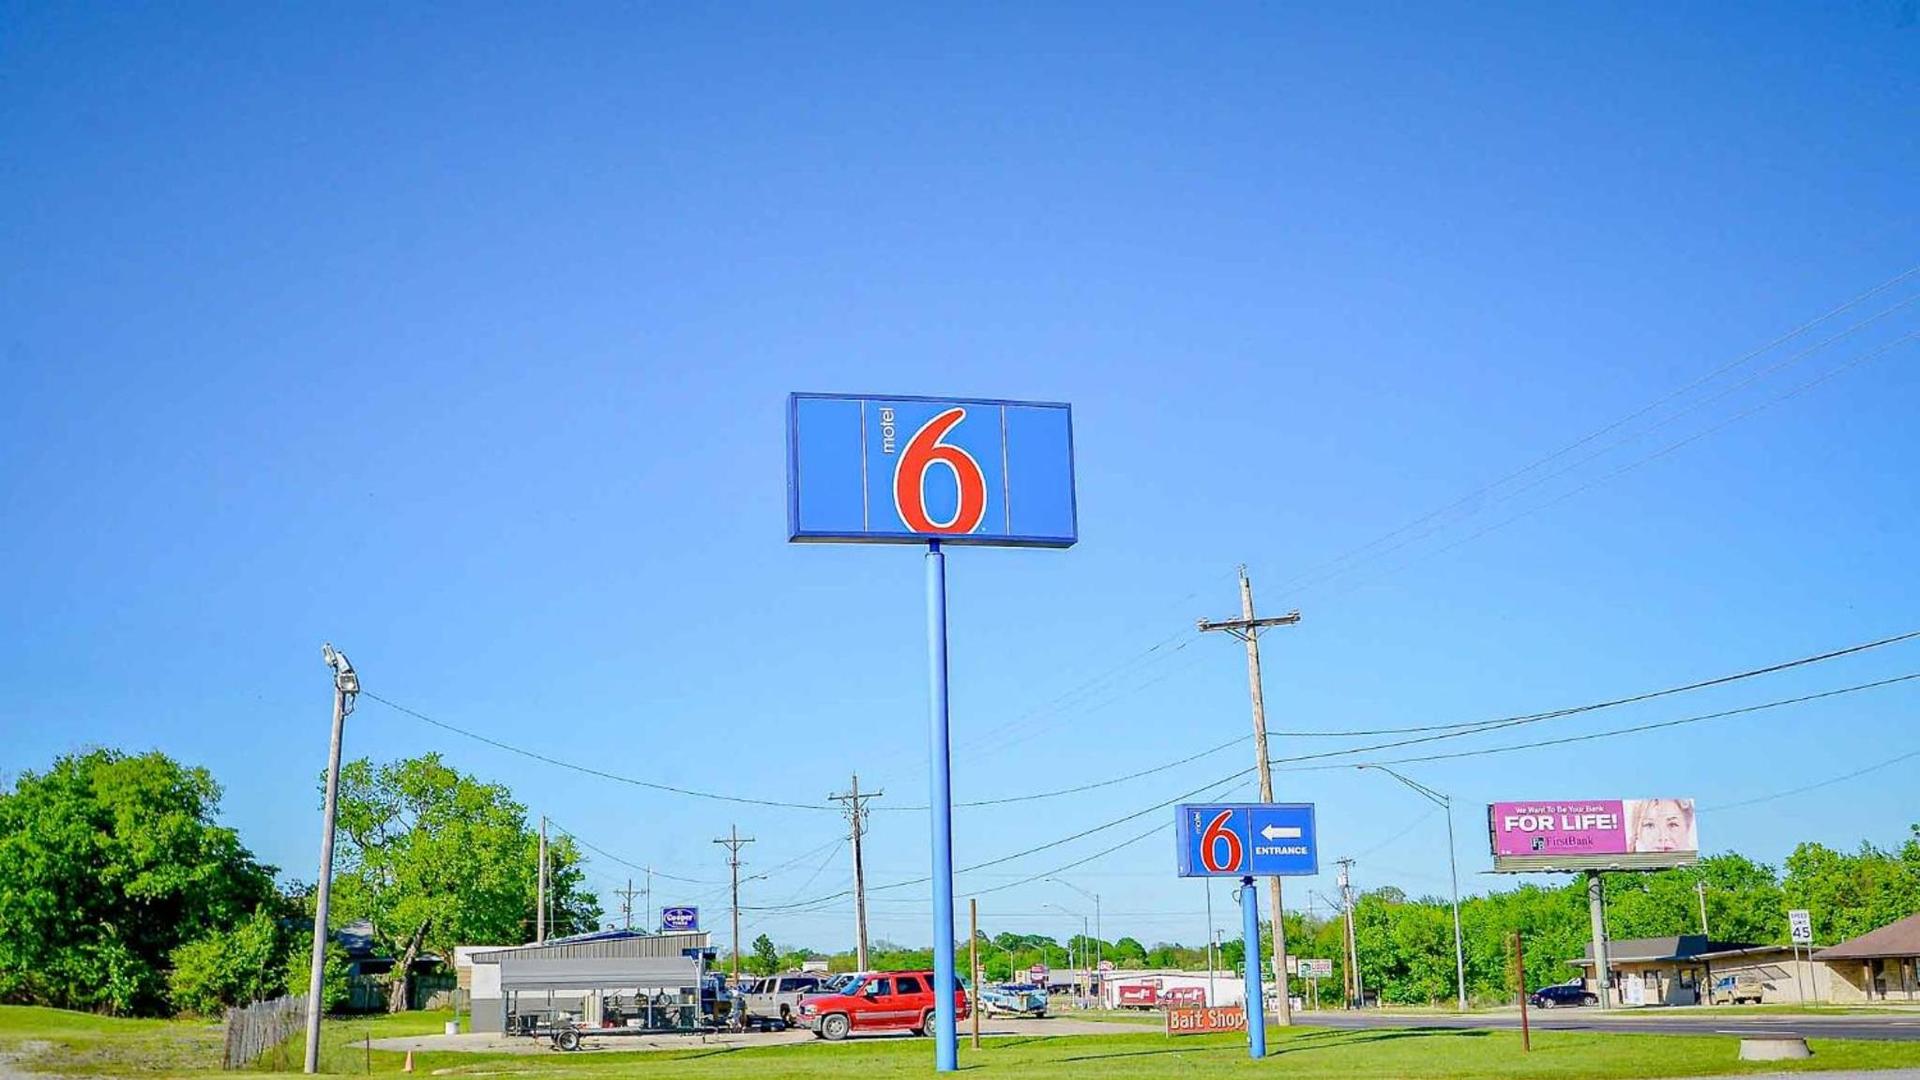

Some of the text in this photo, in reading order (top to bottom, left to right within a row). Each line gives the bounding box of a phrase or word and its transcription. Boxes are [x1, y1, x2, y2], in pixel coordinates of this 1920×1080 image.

[879, 407, 895, 453] motel
[893, 407, 987, 534] 6
[1516, 806, 1526, 814] We
[1527, 806, 1546, 814] Want
[1568, 805, 1585, 813] Your
[1504, 813, 1618, 832] FOR LIFE!
[1201, 809, 1243, 873] 6
[1546, 835, 1594, 847] FirstBank
[1255, 846, 1308, 855] ENTRANCE
[666, 913, 693, 922] Cooper
[1792, 926, 1811, 938] 45
[1170, 1008, 1244, 1029] Bait Shop
